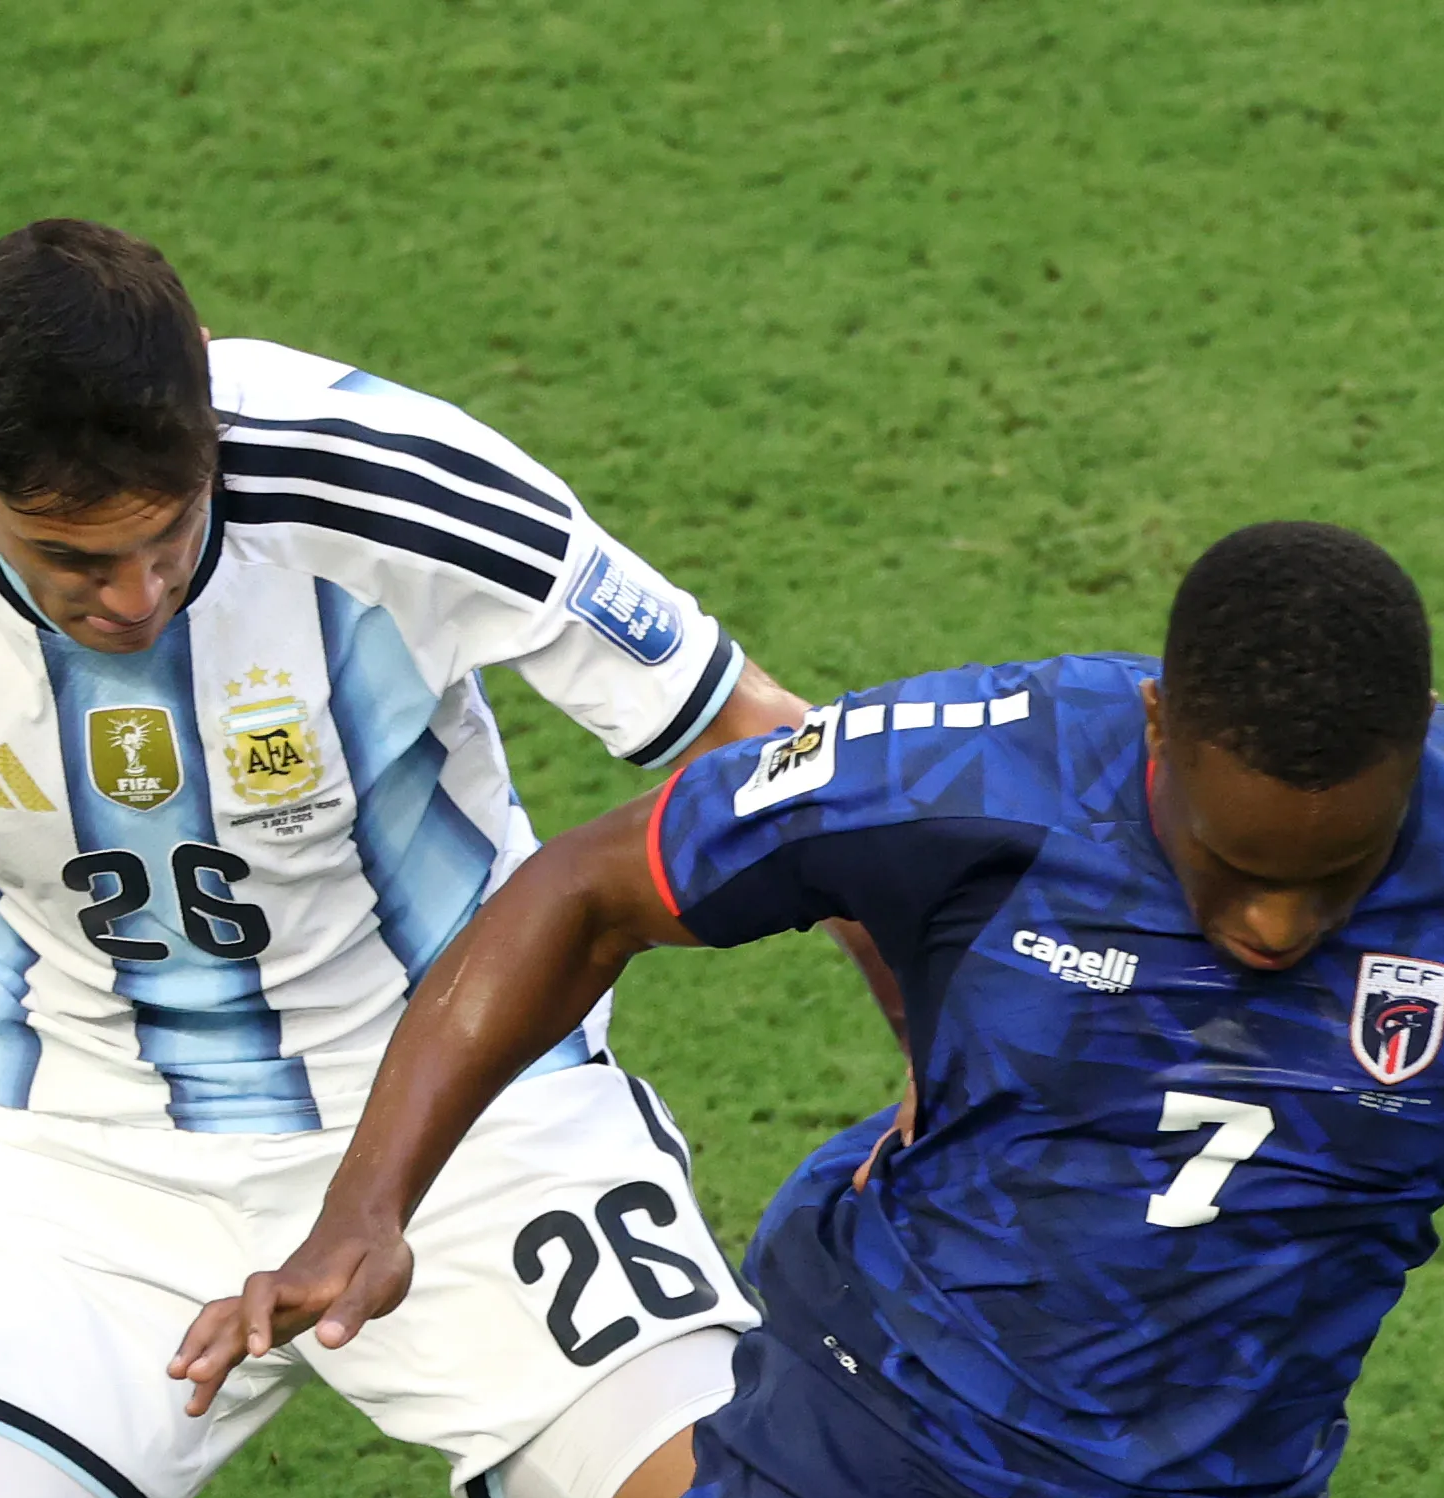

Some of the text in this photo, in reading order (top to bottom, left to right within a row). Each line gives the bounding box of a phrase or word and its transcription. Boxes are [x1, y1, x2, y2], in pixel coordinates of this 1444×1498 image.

[247, 728, 304, 776] AFA
[117, 777, 162, 791] FIFA
[61, 841, 271, 962] 26
[1012, 930, 1139, 985] capelli
[1059, 968, 1131, 994] SPORT
[1368, 963, 1444, 986] FCF
[1145, 1091, 1276, 1228] 7
[513, 1181, 719, 1367] 26
